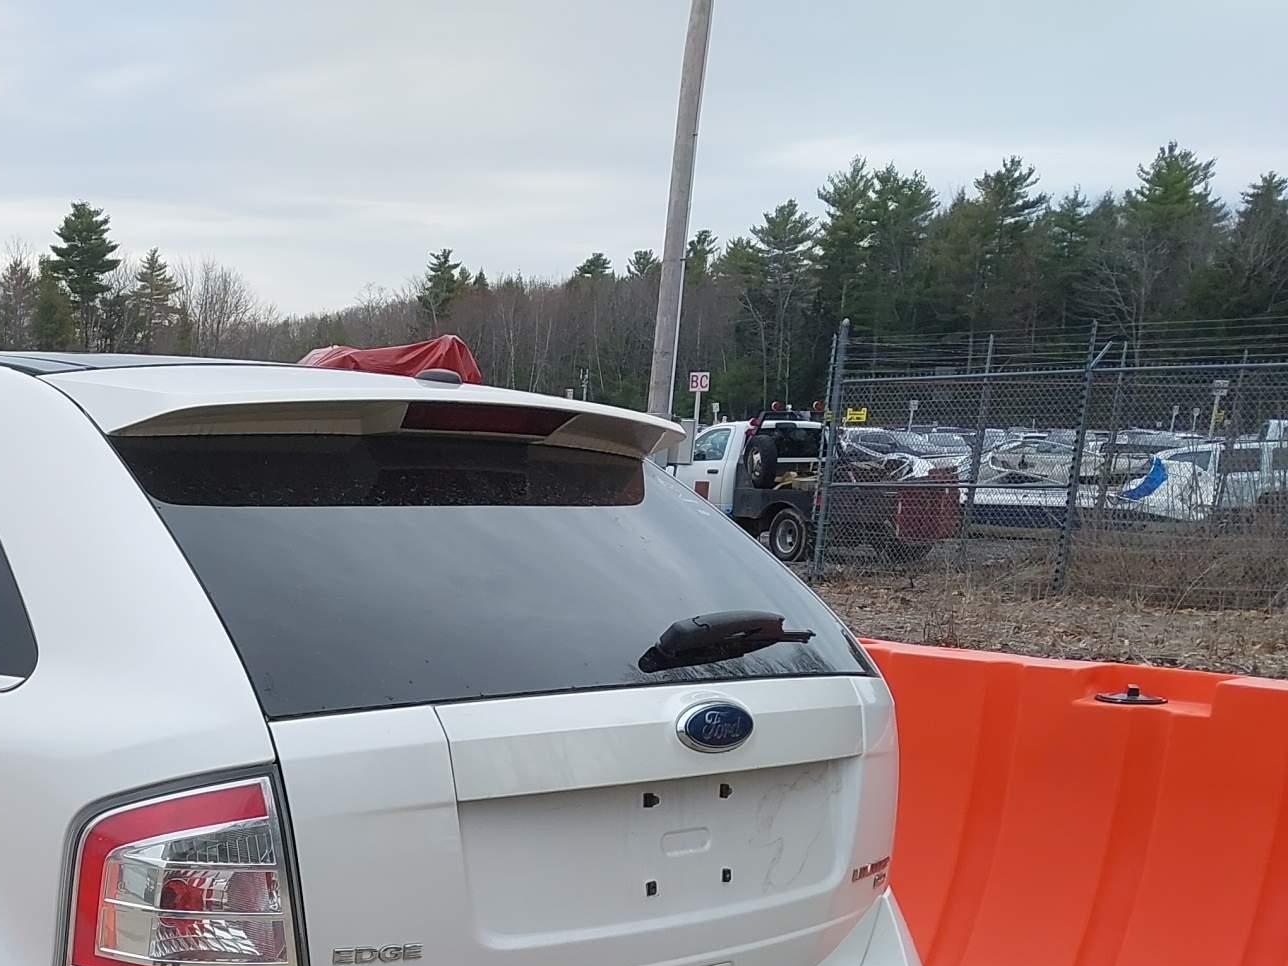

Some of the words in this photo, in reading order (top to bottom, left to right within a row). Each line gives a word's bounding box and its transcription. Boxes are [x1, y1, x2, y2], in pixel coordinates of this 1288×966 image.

[690, 375, 708, 389] BC
[702, 710, 743, 739] Ford
[332, 943, 423, 965] EDGE
